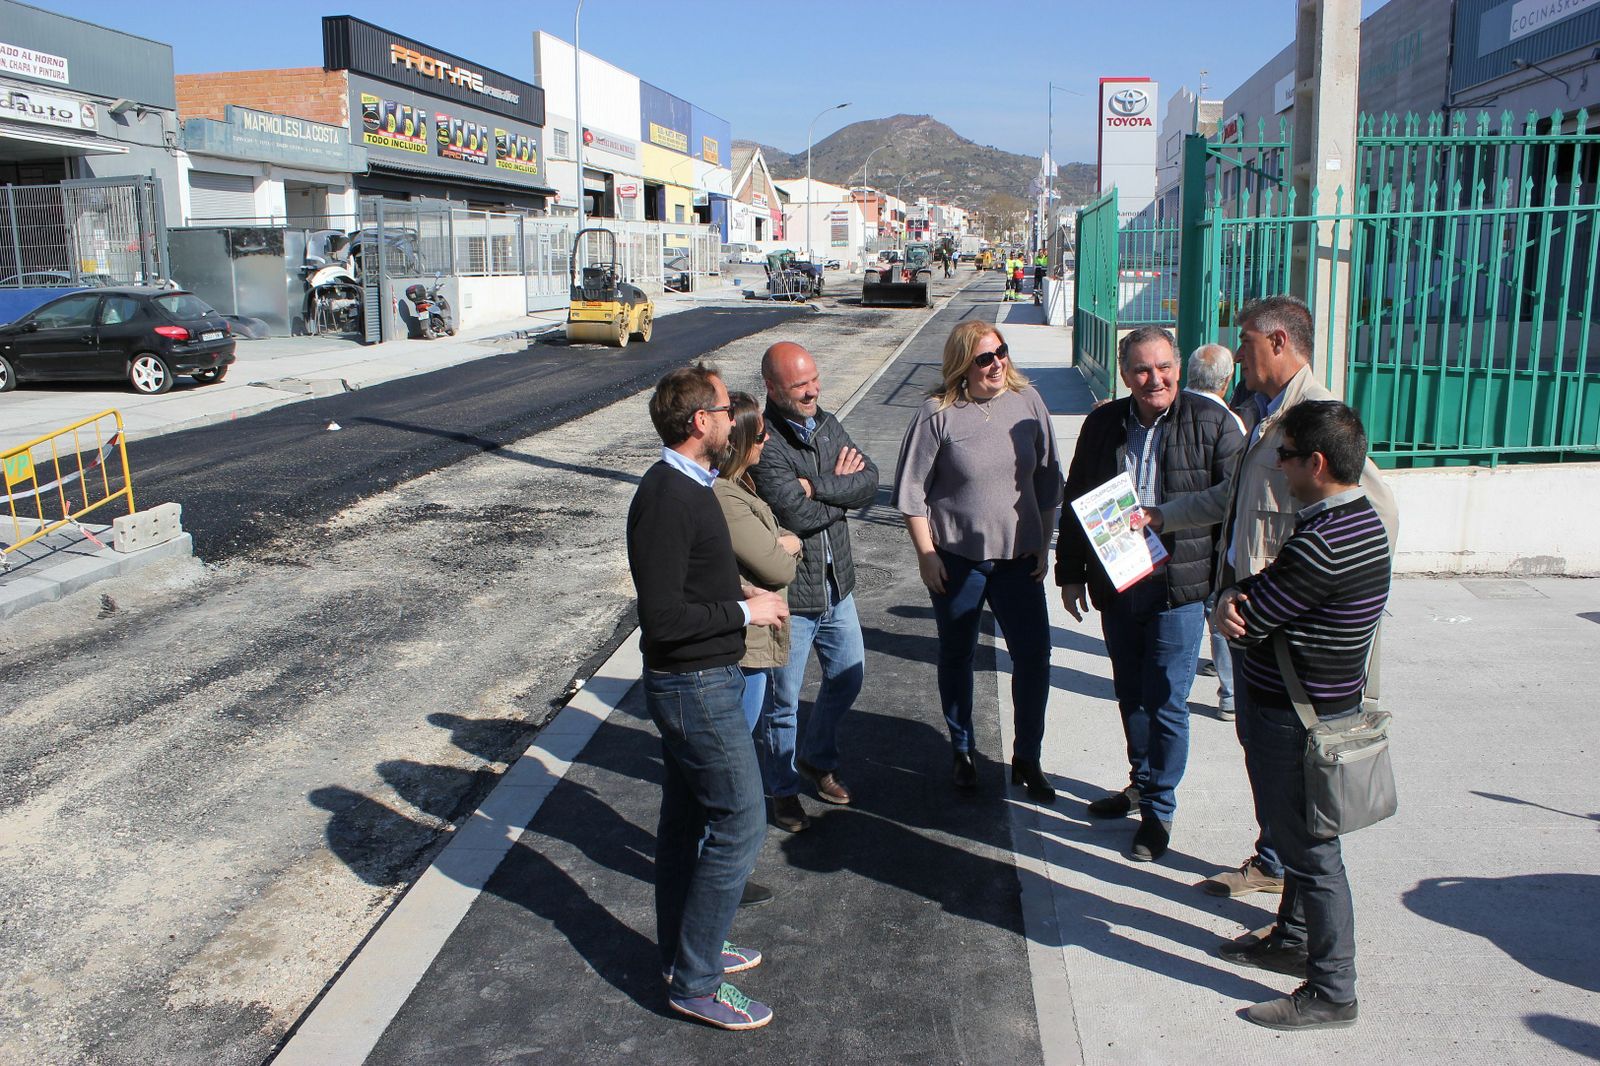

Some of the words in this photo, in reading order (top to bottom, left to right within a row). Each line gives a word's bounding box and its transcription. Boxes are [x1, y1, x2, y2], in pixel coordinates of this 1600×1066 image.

[21, 51, 32, 61] AL
[35, 54, 64, 68] HORNO
[390, 43, 484, 93] PROTYRE
[9, 60, 31, 72] CHAPA
[33, 65, 38, 74] Y
[39, 66, 65, 80] PINTURA
[243, 111, 299, 138] MARMOLES
[312, 125, 339, 145] COSTA
[1106, 117, 1152, 127] TOYOTA
[366, 134, 389, 146] TODO
[391, 139, 427, 153] INCLUIDO
[442, 149, 485, 164] PROTYRE
[498, 160, 512, 169] TODO
[514, 163, 536, 174] INCLUIDO
[4, 454, 29, 477] VP
